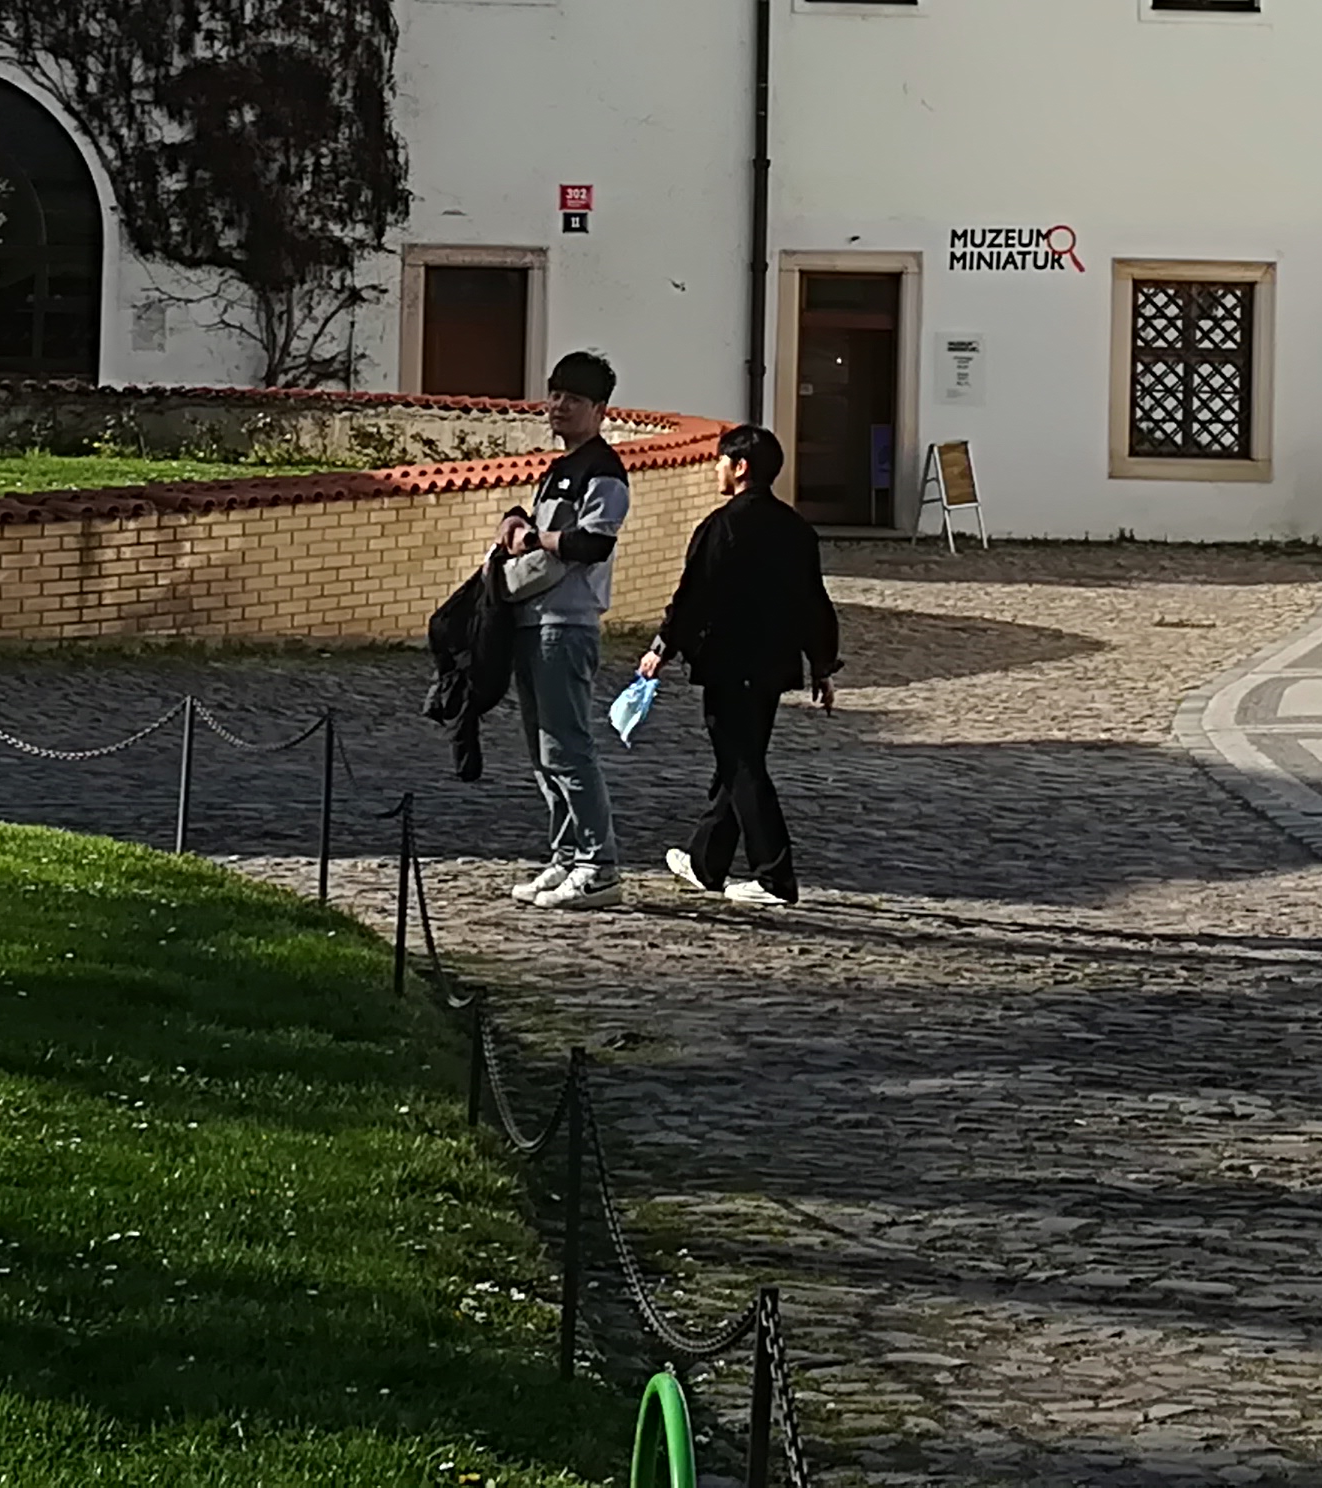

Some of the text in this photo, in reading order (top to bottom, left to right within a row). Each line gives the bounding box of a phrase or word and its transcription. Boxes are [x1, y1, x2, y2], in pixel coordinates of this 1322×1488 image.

[565, 188, 587, 199] 302
[950, 228, 1052, 248] MUZEUM
[949, 250, 1065, 271] MINIATUR
